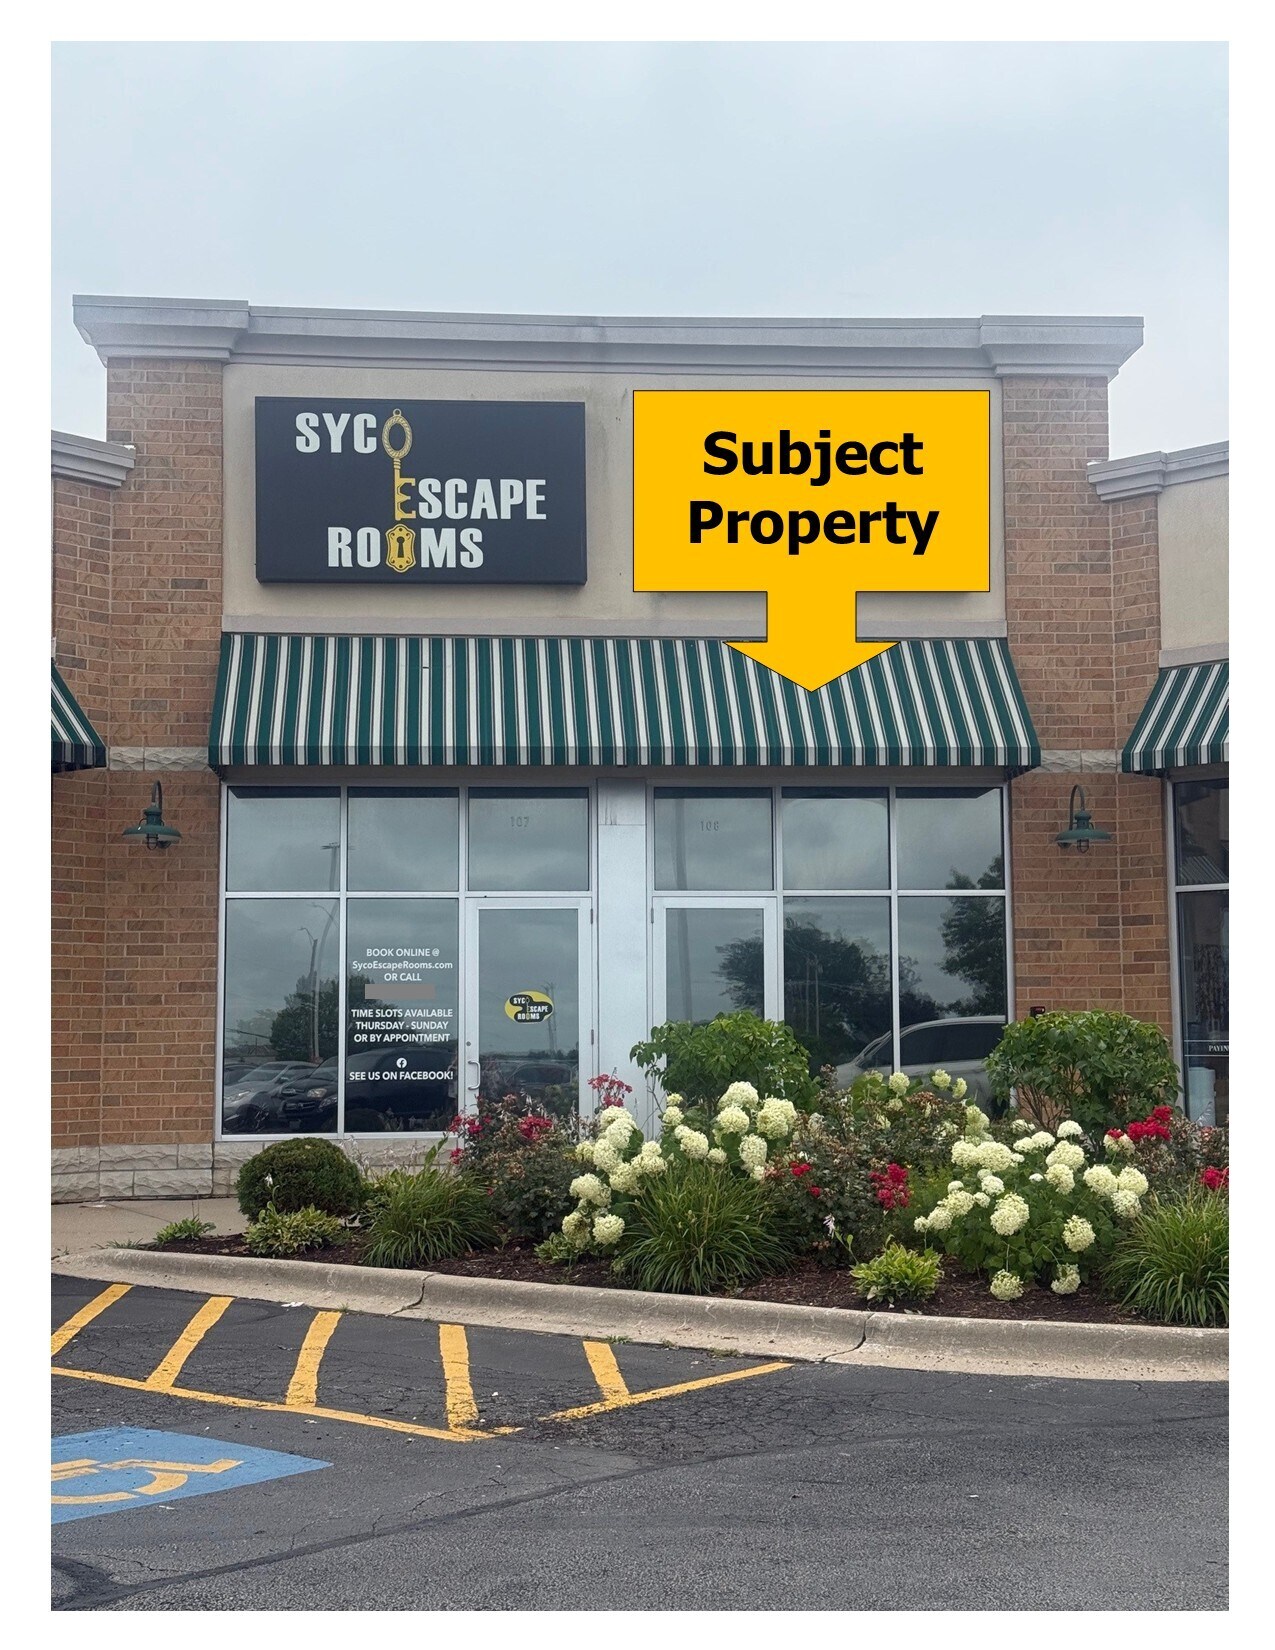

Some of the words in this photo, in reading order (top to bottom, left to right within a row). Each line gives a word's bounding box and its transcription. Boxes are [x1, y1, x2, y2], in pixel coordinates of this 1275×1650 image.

[295, 408, 412, 459] SYCO
[394, 477, 547, 521] ESCAPE
[366, 948, 394, 957] BOOK
[395, 948, 431, 957] ONLINE
[352, 960, 453, 972] SycoEscapeRooms.com
[384, 972, 398, 982] OR
[399, 972, 422, 982] CALL
[351, 1009, 374, 1018] TIME
[375, 1009, 403, 1018] SLOTS
[404, 1008, 453, 1018] AVAILABLE
[356, 1021, 405, 1030] THURSDAY
[411, 1021, 449, 1030] SUNDAY
[353, 1034, 368, 1043] OR
[369, 1034, 383, 1042] BY
[383, 1033, 451, 1043] APPOINTMENT
[349, 1071, 367, 1081] SEE
[368, 1071, 381, 1080] US
[382, 1071, 398, 1080] ON
[399, 1070, 454, 1080] FACEBOOK!
